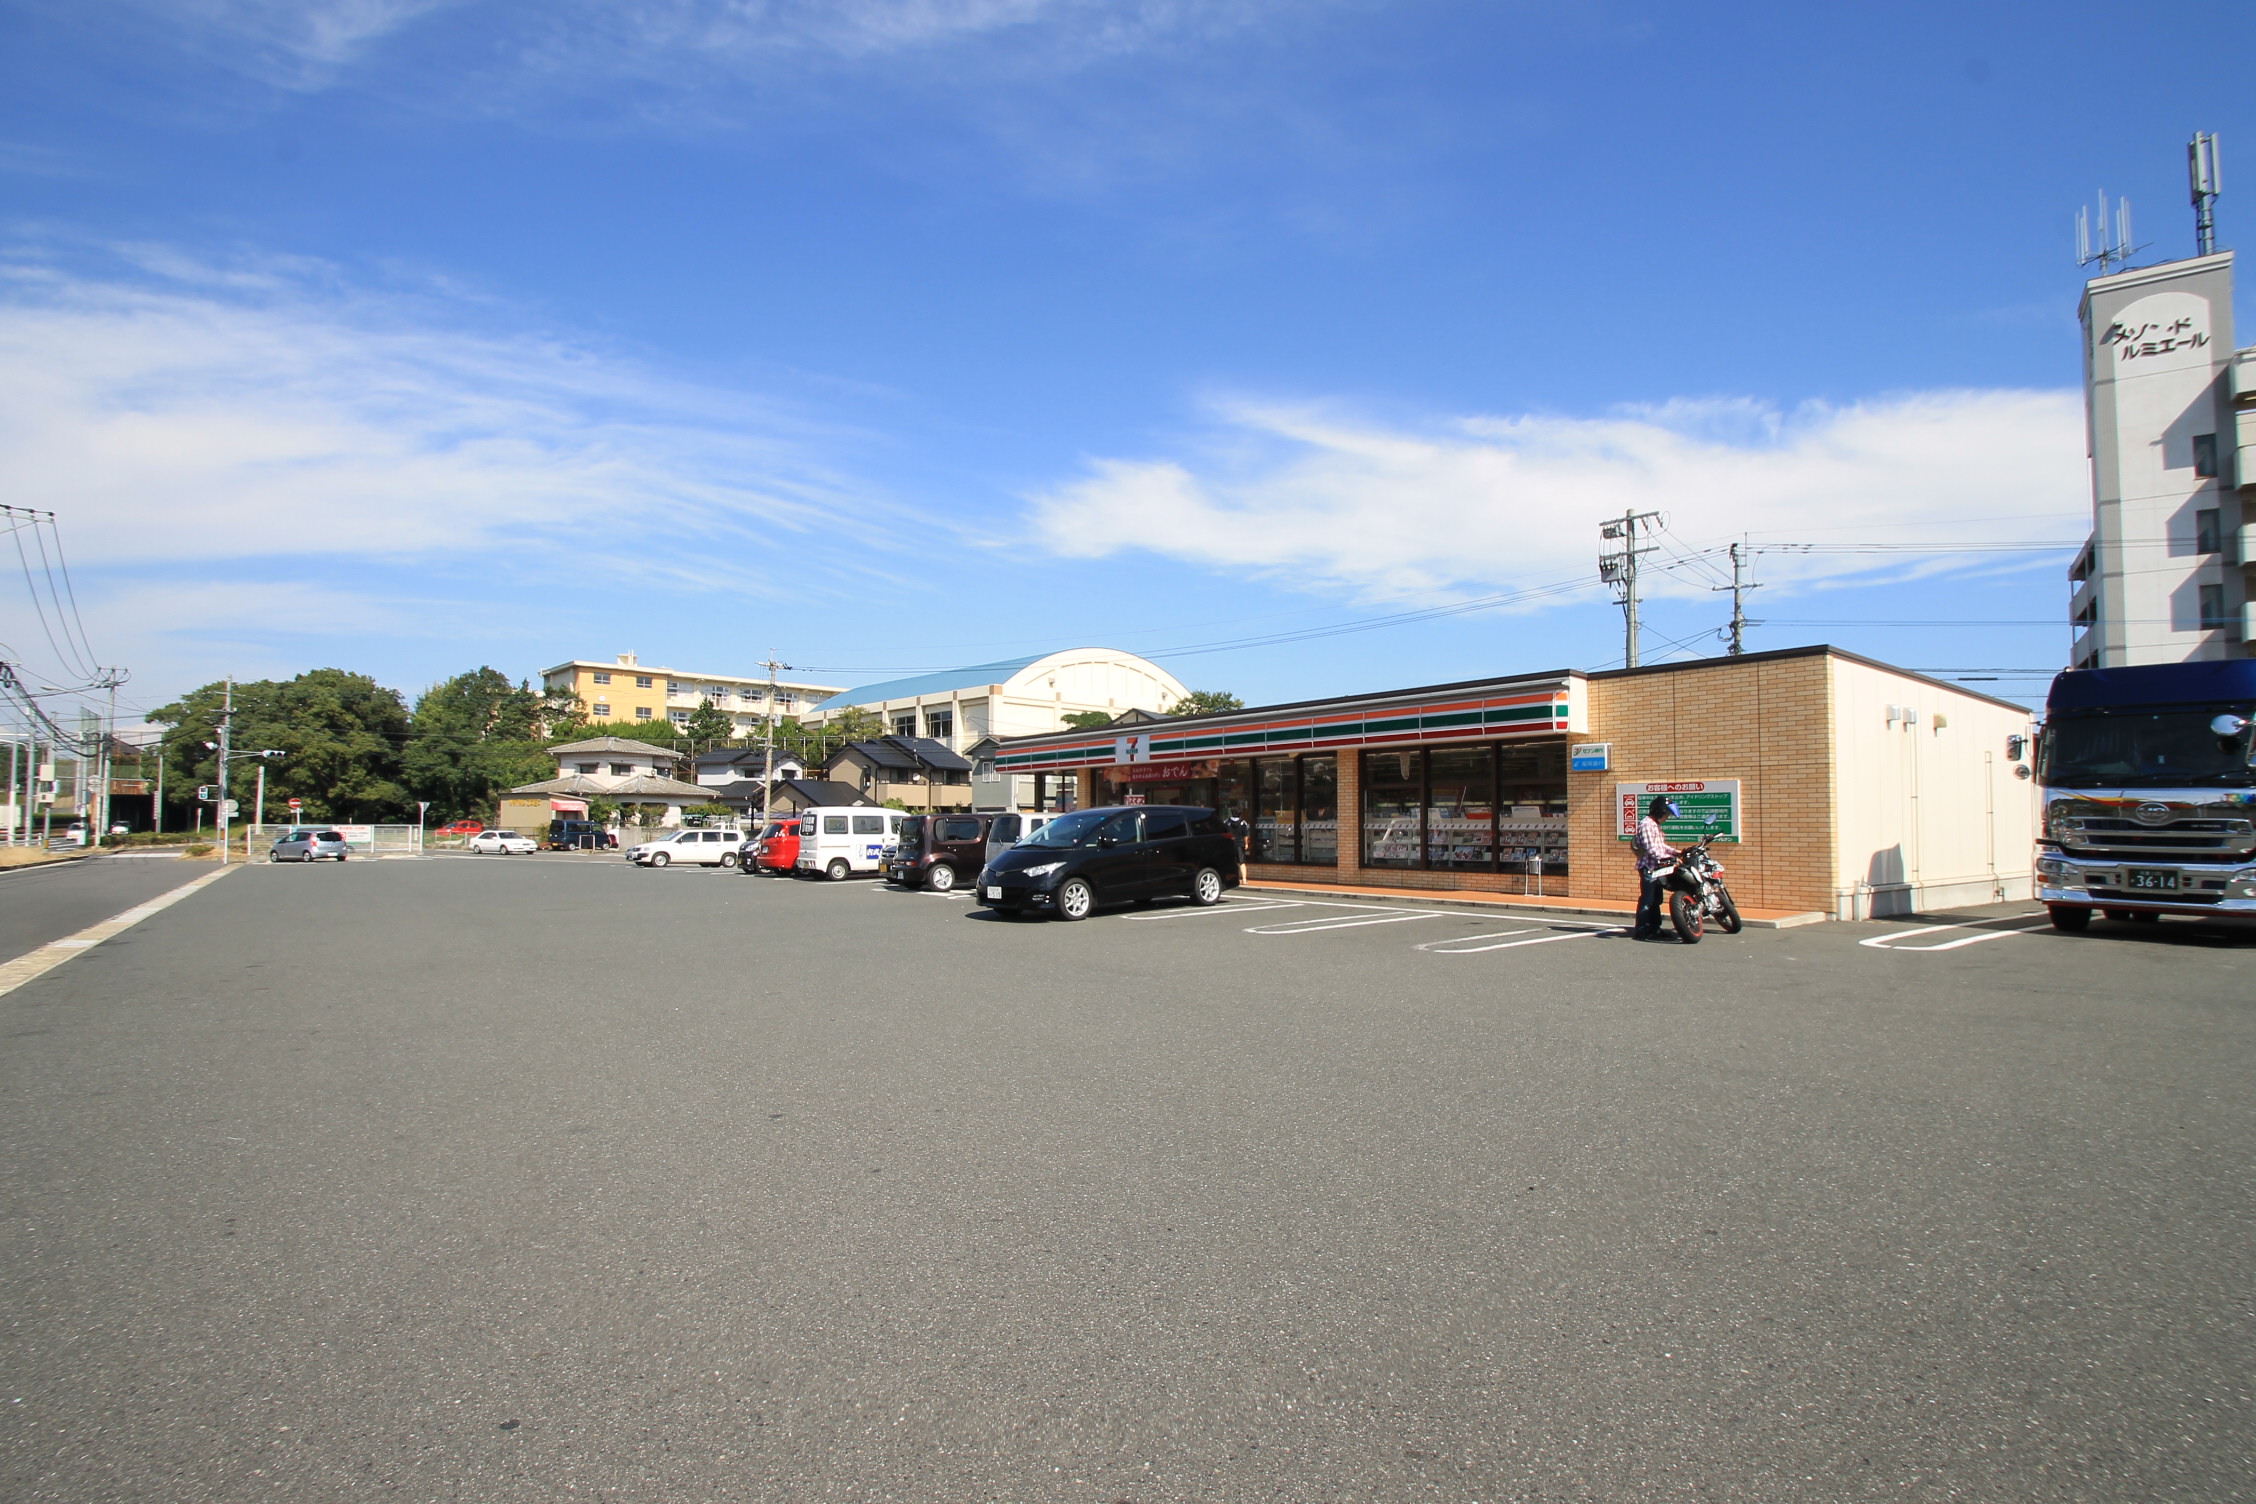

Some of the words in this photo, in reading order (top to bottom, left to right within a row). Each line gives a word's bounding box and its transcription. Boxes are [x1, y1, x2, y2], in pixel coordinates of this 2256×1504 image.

[2121, 332, 2211, 361] ルミエール
[1162, 766, 1188, 778] おでん
[2136, 876, 2175, 889] 36-14
